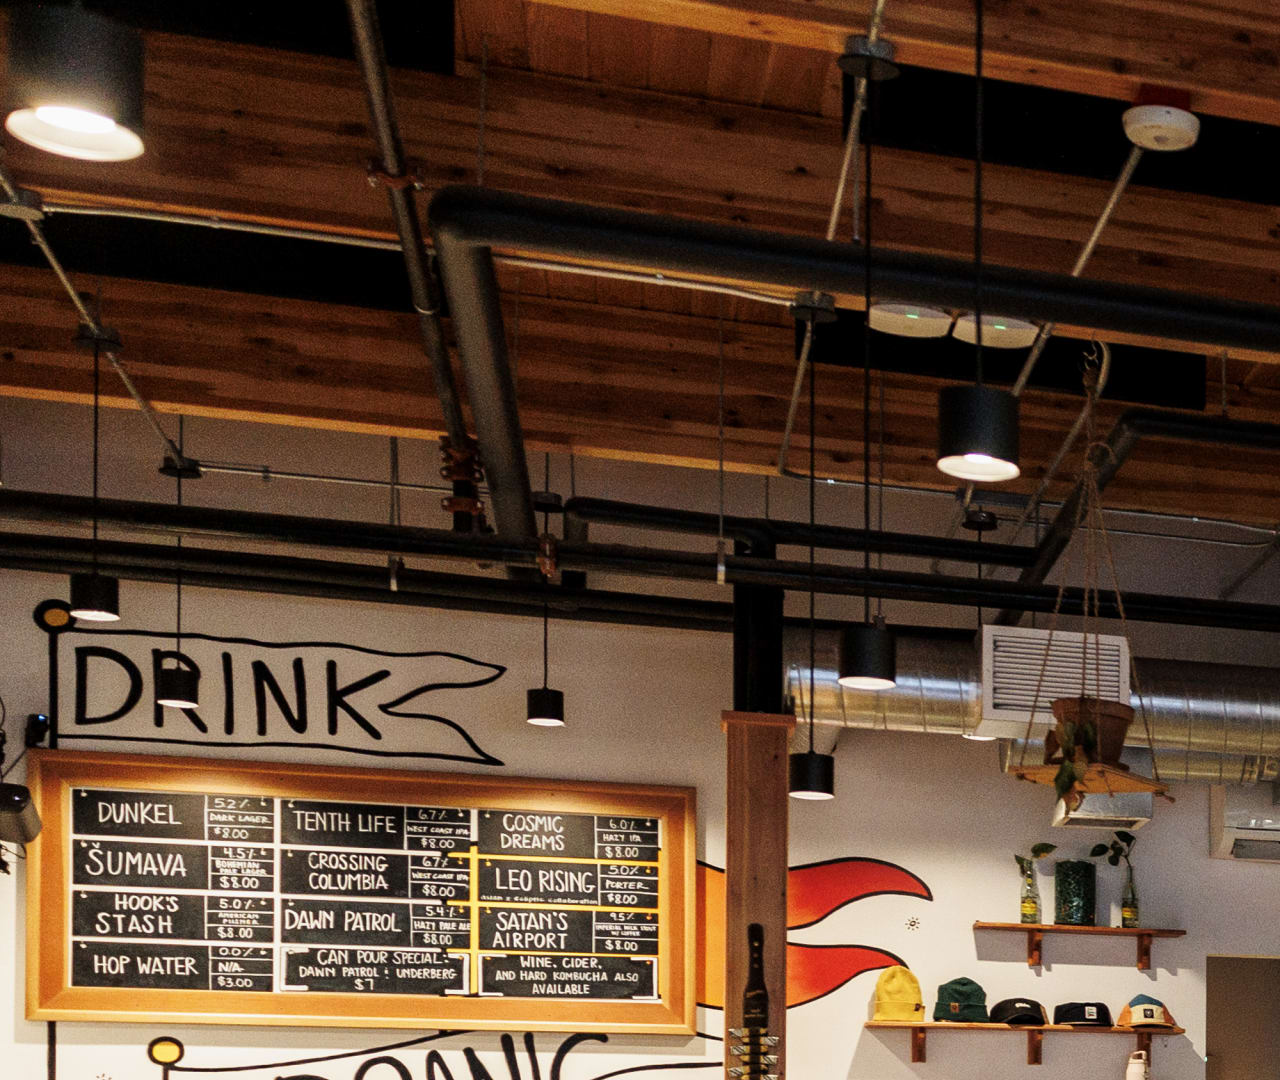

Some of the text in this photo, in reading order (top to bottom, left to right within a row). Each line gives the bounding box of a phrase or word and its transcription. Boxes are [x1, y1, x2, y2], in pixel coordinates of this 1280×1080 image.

[75, 646, 391, 740] DRINK
[97, 801, 183, 825] DUNKEL
[209, 812, 273, 825] DARK LAGER
[293, 810, 398, 834] TENTH LIFE
[502, 813, 565, 833] COSMIC
[214, 827, 249, 840] $8.00
[406, 825, 428, 833] WEST
[430, 827, 454, 835] COAST
[420, 837, 456, 849] $8.00
[500, 833, 566, 851] DREAMS
[602, 833, 643, 843] HAZY IPA
[85, 841, 188, 877] ŠUMAVA
[223, 847, 257, 860] 4.5%
[307, 851, 390, 872] CROSSING
[219, 876, 259, 889] $8.00
[308, 872, 390, 891] COLUMBIA
[495, 867, 597, 893] LEO RISING
[605, 879, 651, 890] PORTER
[422, 884, 456, 897] $8.00
[114, 893, 180, 913] HOOK'S
[219, 898, 256, 911] 5.0%
[606, 893, 638, 905] $8.00
[218, 912, 260, 920] AMERICAN
[284, 908, 402, 932] DAWN PATROL
[495, 911, 569, 931] SATAN'S
[95, 912, 174, 934] STASH
[413, 920, 471, 931] HAZY PALE ALE
[217, 927, 253, 939] $8.00
[423, 933, 453, 945] $8.00
[492, 931, 569, 949] AIRPORT
[218, 947, 253, 957] 0.0%
[316, 949, 450, 966] CAN POUR SPECIAL:
[93, 954, 199, 976] HOP WATER
[217, 962, 245, 973] N/A
[299, 966, 337, 978] DAWN
[341, 967, 380, 978] PATROL
[396, 968, 458, 980] UNDERBERG
[495, 970, 639, 982] AND HARD KOMBUCHA ALSO
[217, 976, 253, 989] $3.00
[354, 978, 375, 991] $7
[531, 983, 591, 995] AVAILABLE
